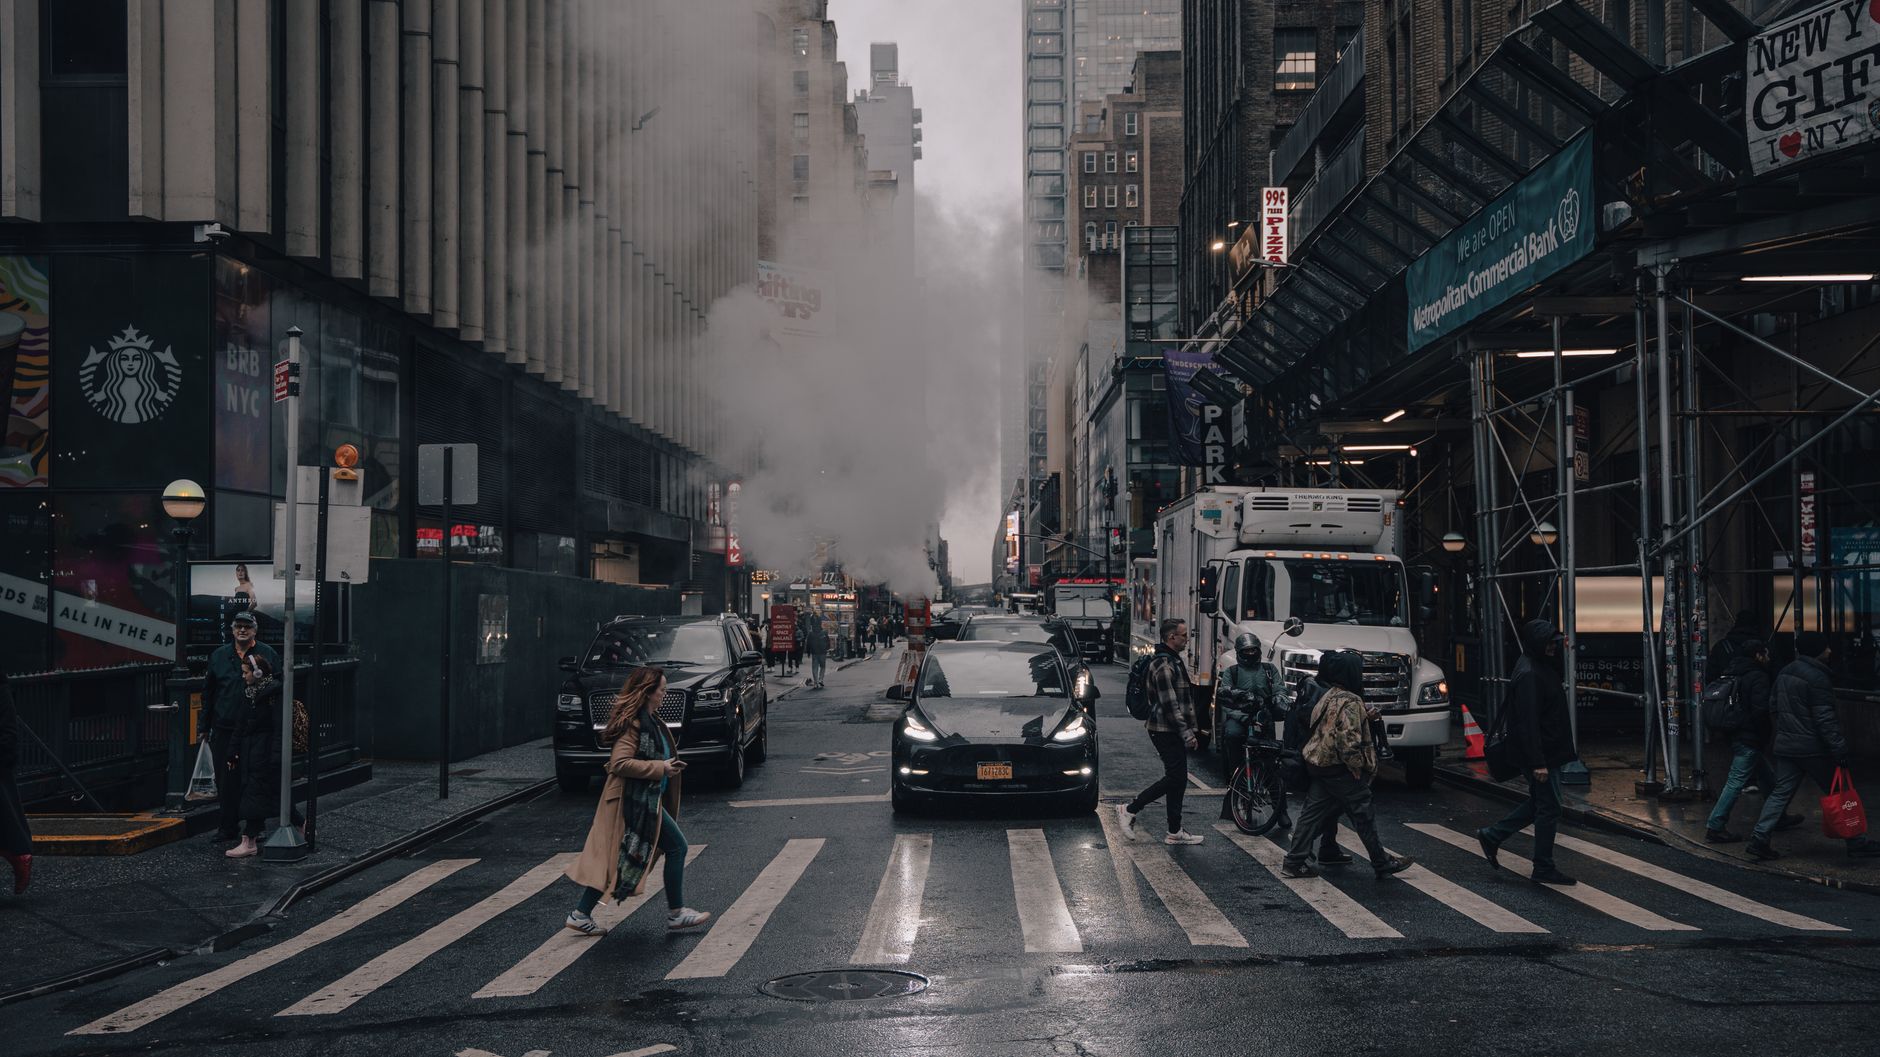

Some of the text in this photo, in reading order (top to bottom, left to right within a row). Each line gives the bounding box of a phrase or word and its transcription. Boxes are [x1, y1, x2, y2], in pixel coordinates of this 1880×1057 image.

[1753, 9, 1836, 76] NEW
[1753, 43, 1880, 131] GIF
[1767, 115, 1853, 164] I NY
[1265, 190, 1285, 206] 99¢
[1266, 217, 1284, 263] PIZZA
[1457, 200, 1516, 263] We are OPEN
[1413, 218, 1559, 334] Metropolitan Commercial Bank
[227, 342, 260, 377] BRB
[227, 383, 260, 418] NYC
[1204, 405, 1227, 484] PARK
[60, 606, 175, 648] ALL IN THE AP
